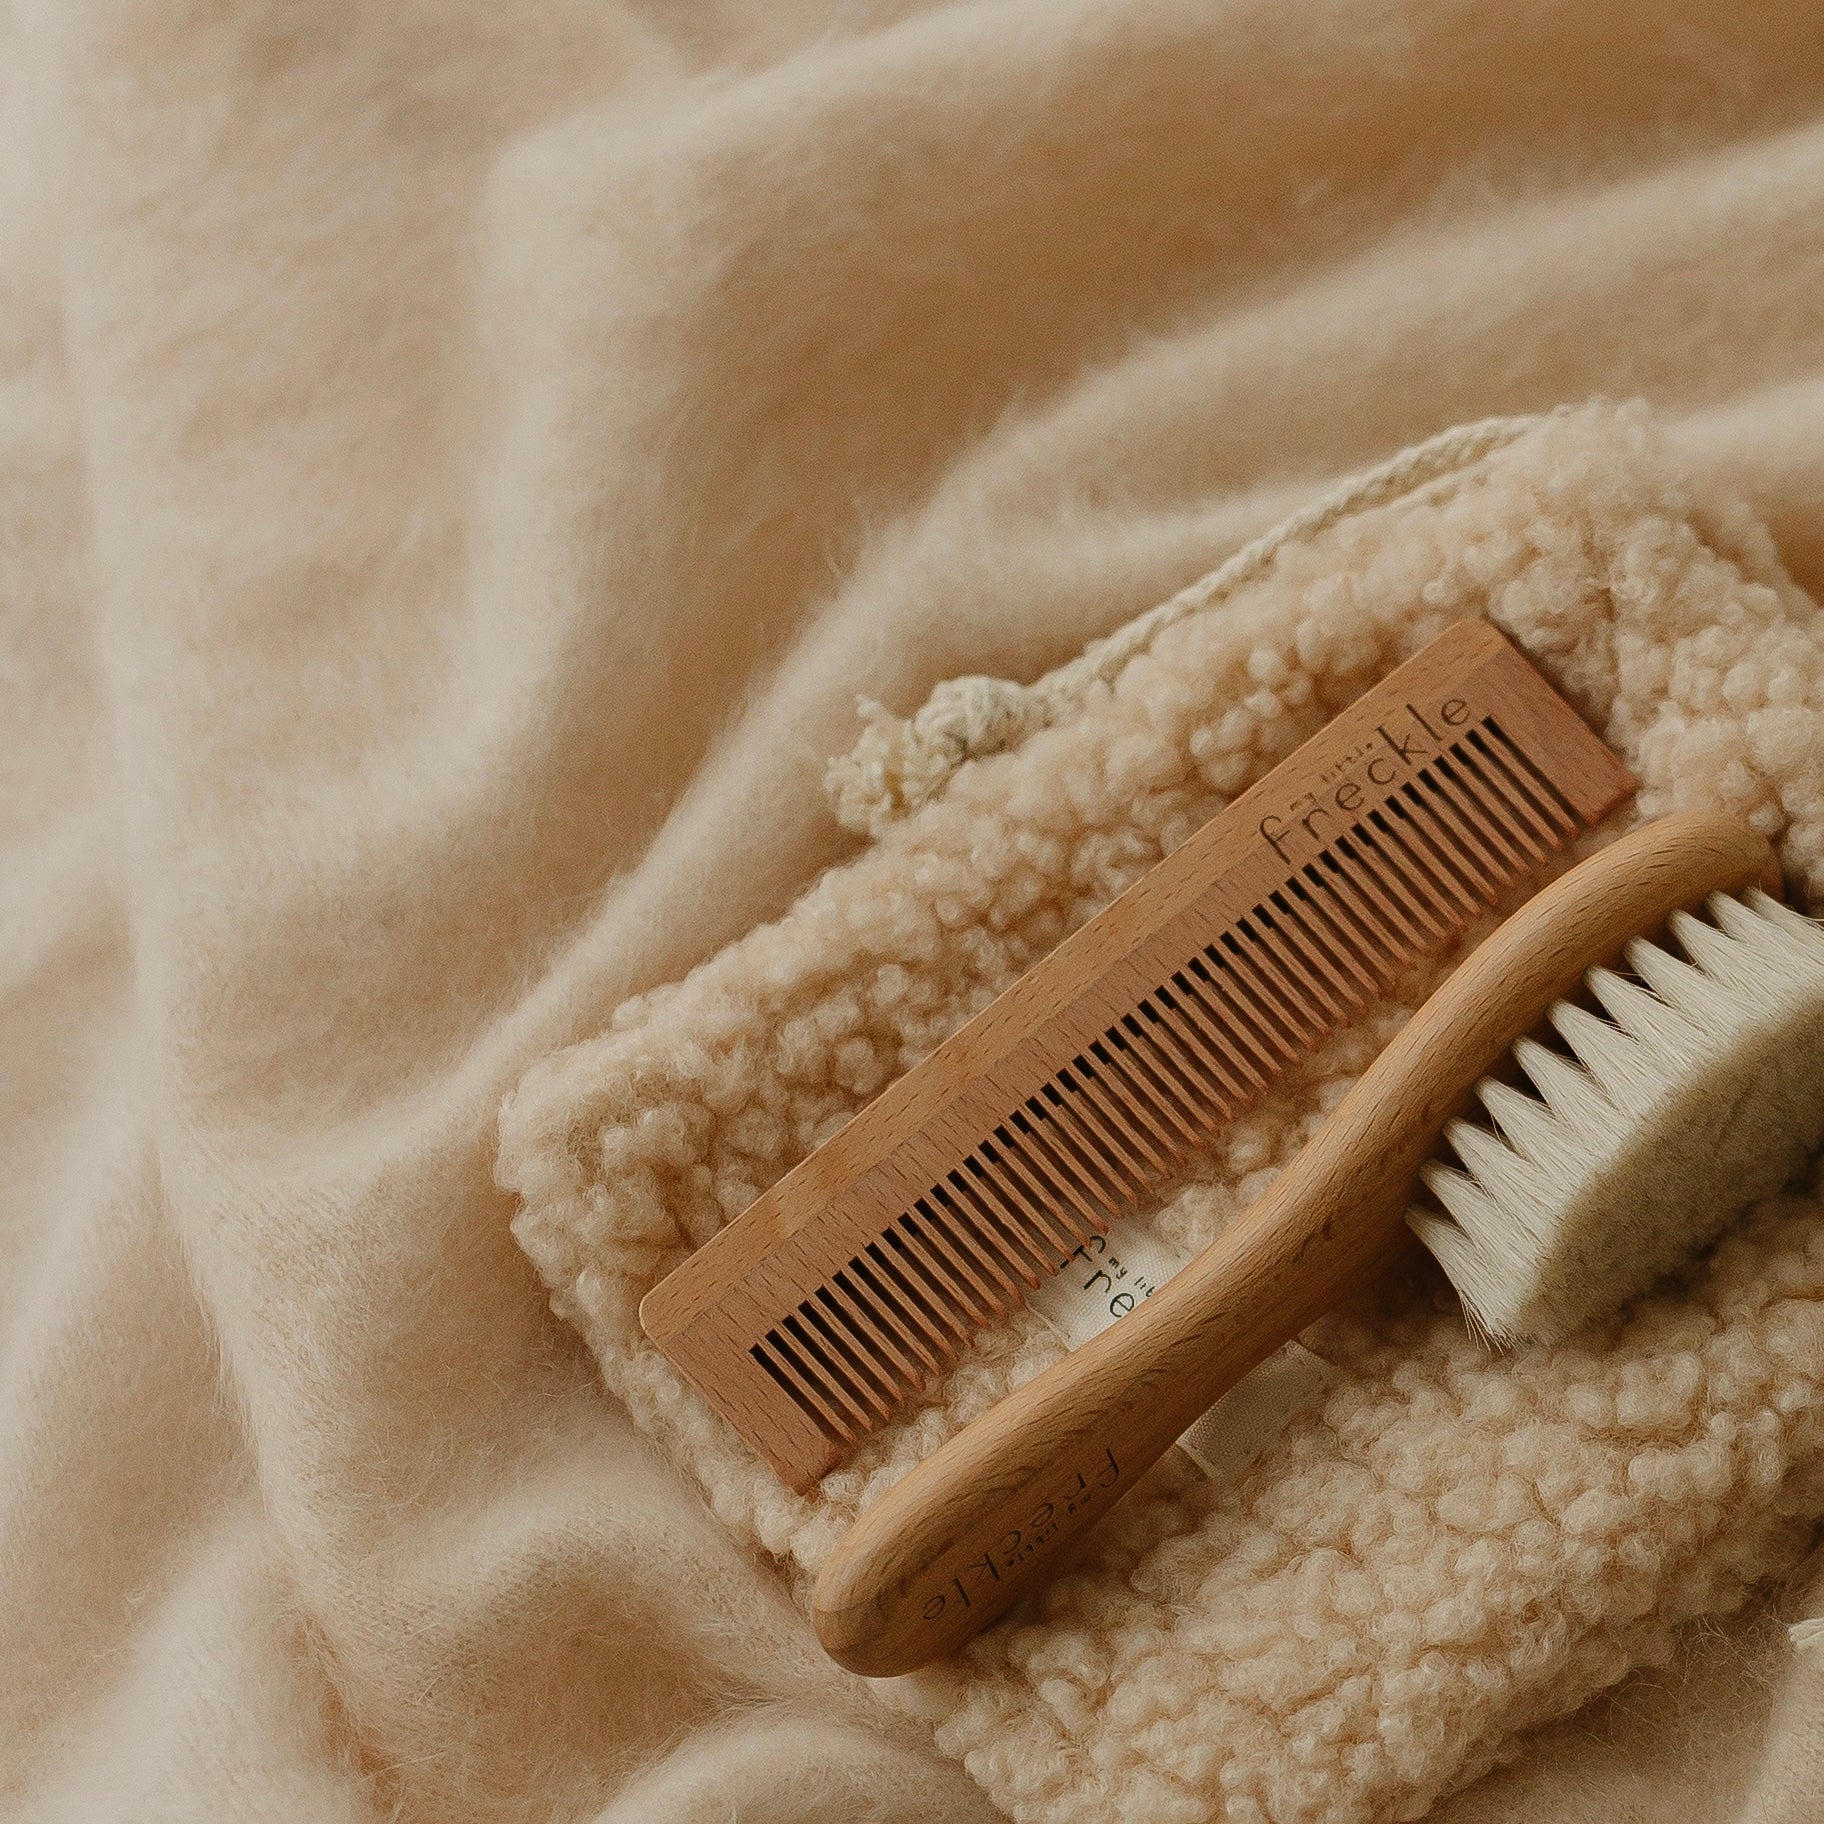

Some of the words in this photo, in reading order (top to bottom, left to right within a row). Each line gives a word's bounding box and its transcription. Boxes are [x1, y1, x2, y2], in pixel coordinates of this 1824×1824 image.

[1259, 698, 1471, 866] freckle
[1108, 1256, 1129, 1280] my
[1134, 1276, 1156, 1298] lit
[922, 1447, 1121, 1621] freckle
